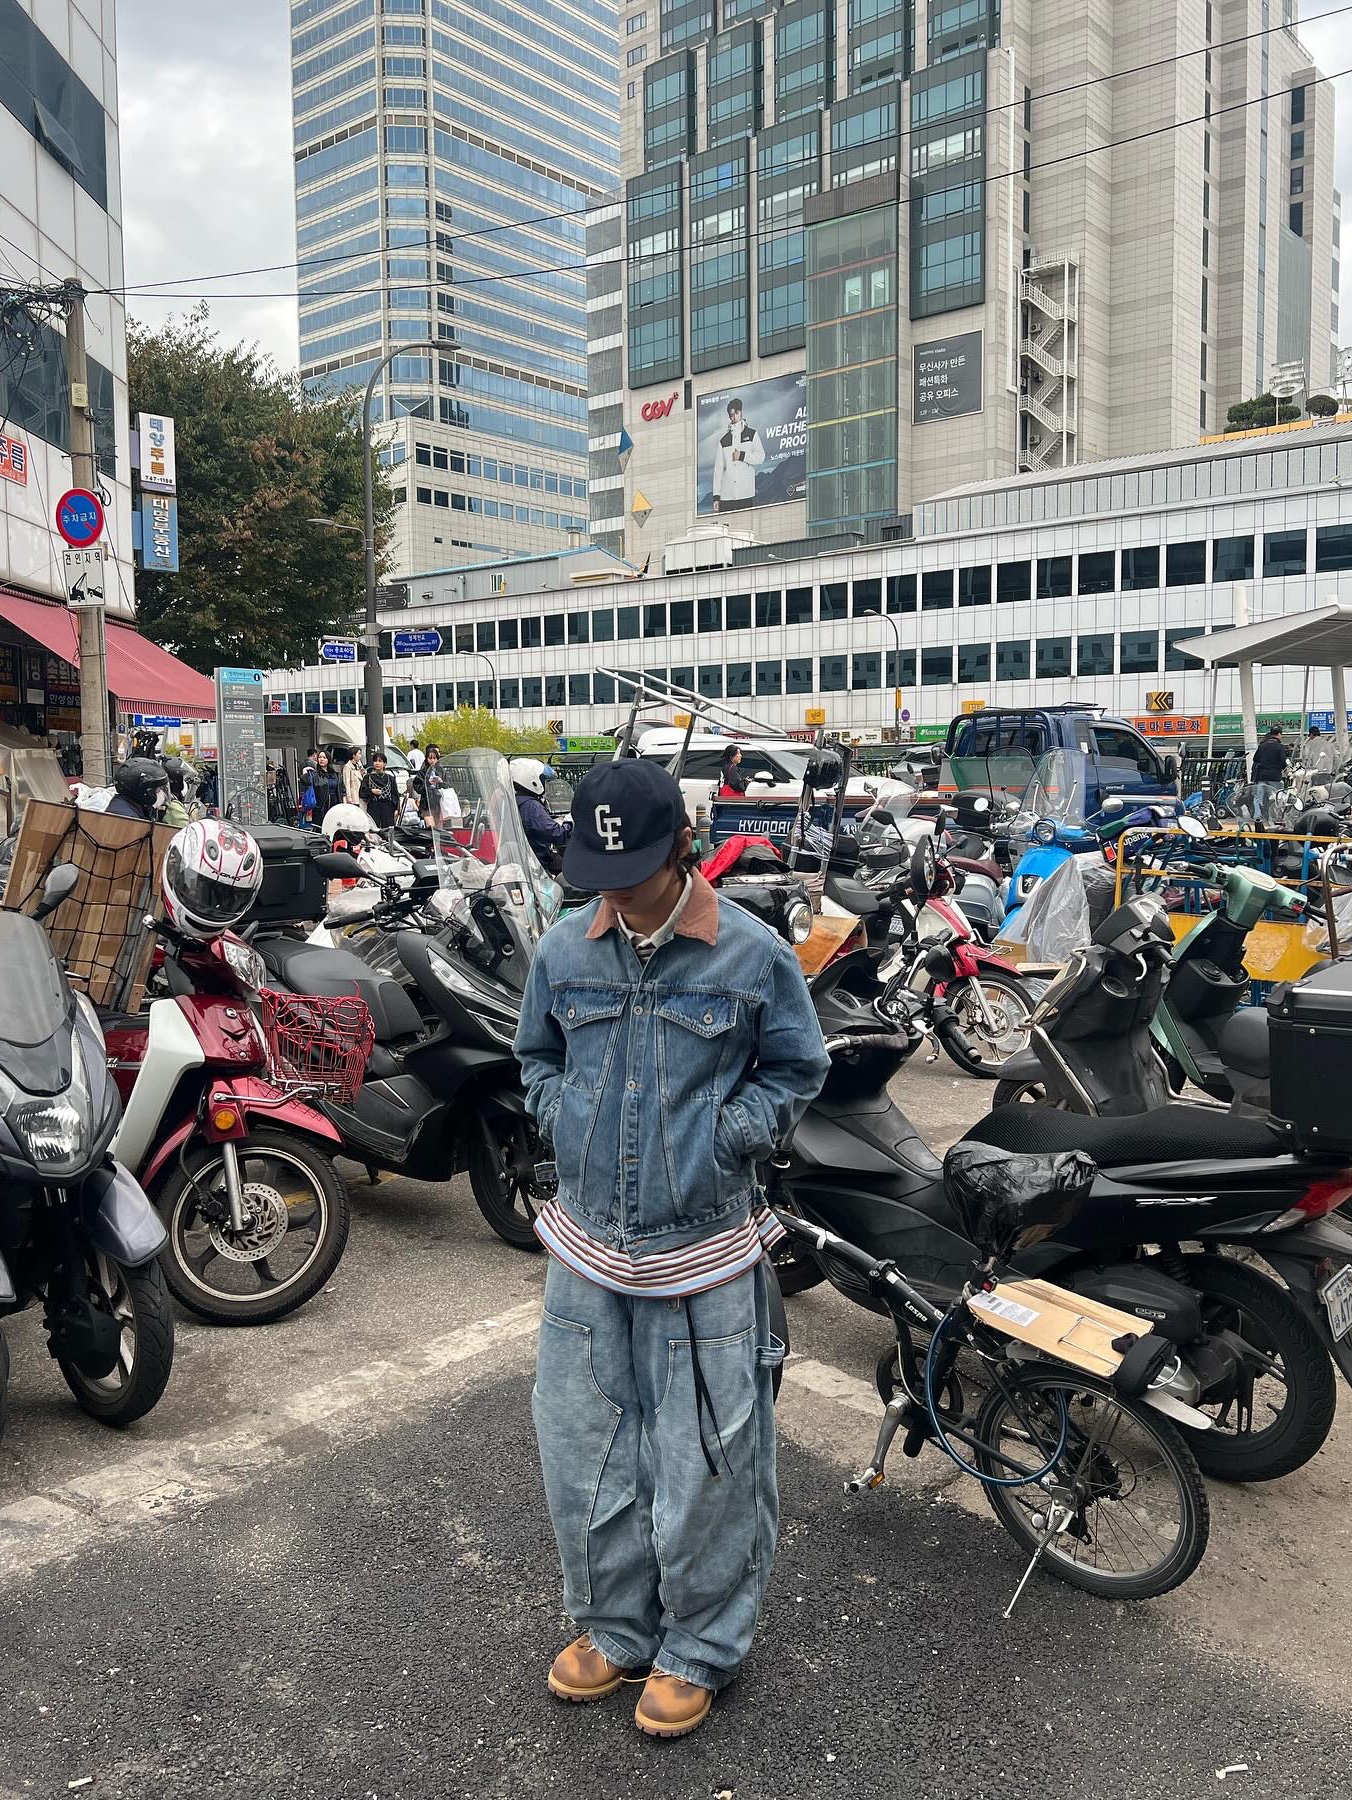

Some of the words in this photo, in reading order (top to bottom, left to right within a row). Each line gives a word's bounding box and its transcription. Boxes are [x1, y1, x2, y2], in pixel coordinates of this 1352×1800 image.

[919, 361, 948, 373] 무신사가
[950, 355, 966, 368] 만든
[919, 374, 948, 387] 패션특화
[919, 391, 934, 403] 공유
[936, 387, 959, 399] 오피스
[642, 398, 674, 421] CGV
[766, 421, 806, 438] WEATHE
[149, 418, 165, 475] 태양주름
[780, 434, 806, 449] PROO
[62, 511, 97, 524] 주차금지
[65, 551, 101, 566] 견인지역
[738, 819, 791, 834] HYUNDAI
